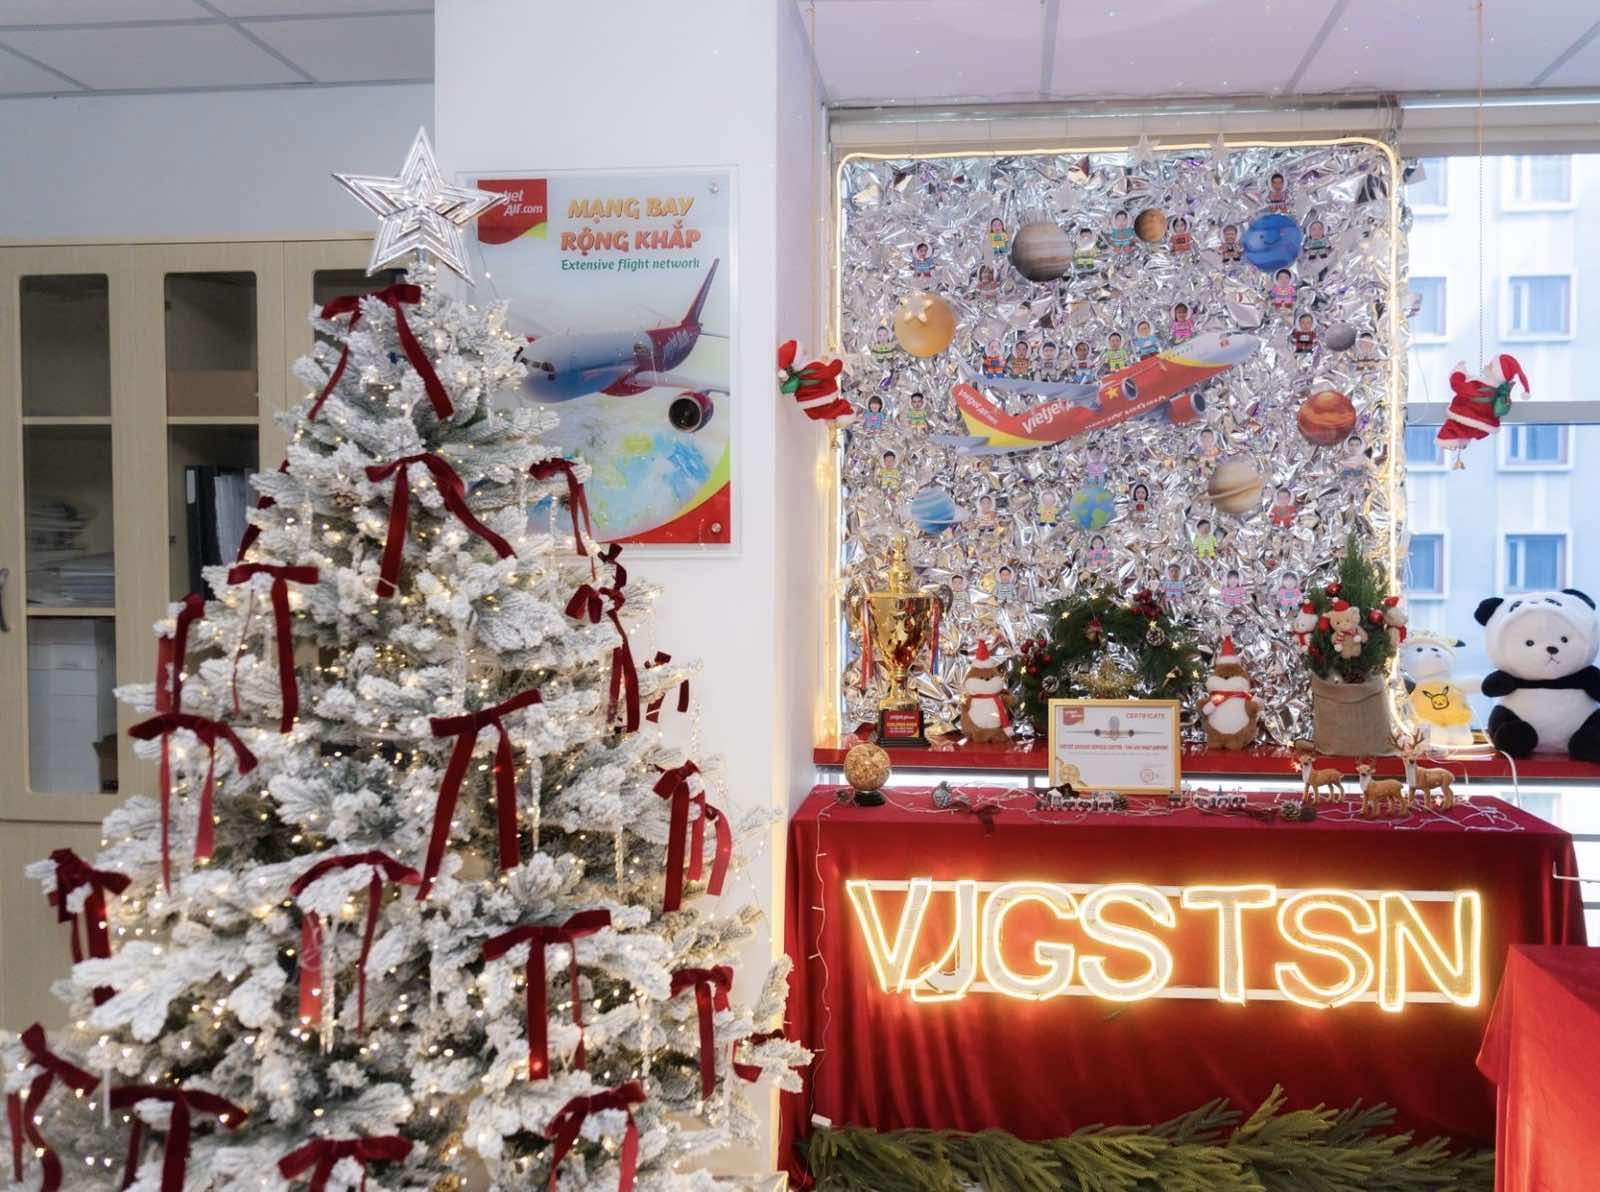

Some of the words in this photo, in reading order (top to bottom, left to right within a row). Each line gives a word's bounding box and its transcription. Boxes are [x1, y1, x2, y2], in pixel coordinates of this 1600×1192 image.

[567, 197, 640, 223] MẠNG
[646, 196, 695, 217] BAY
[560, 226, 630, 256] RỘNG
[635, 220, 702, 250] KHẮP
[561, 259, 615, 271] Extensive
[617, 258, 650, 272] flight
[652, 257, 700, 269] network
[1125, 712, 1166, 720] CERTIFICATE
